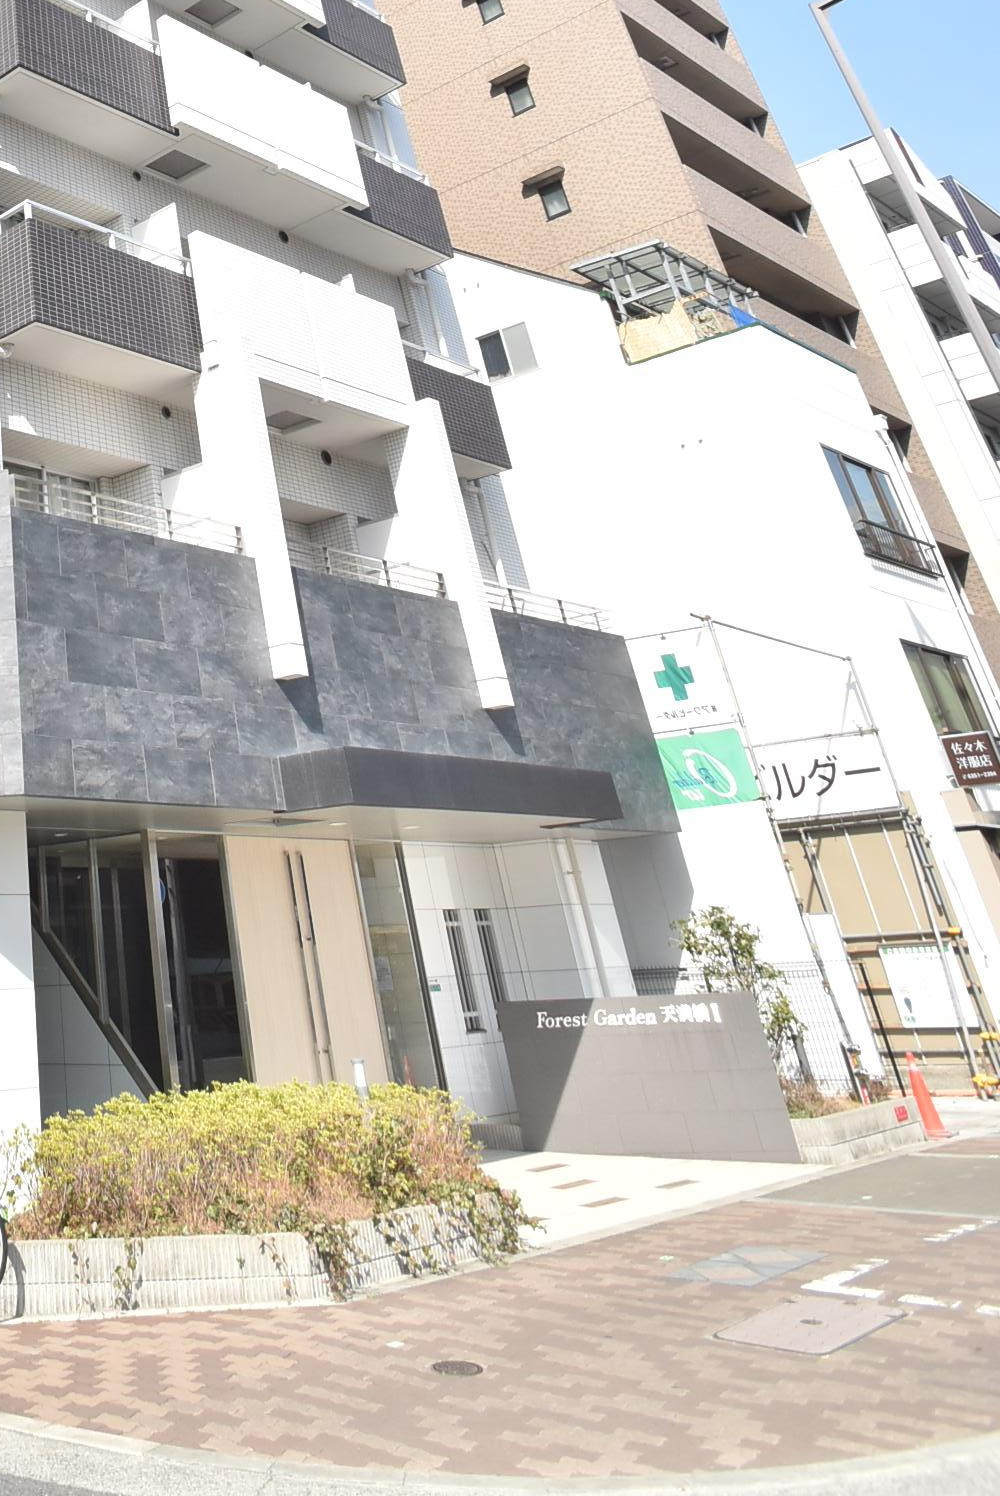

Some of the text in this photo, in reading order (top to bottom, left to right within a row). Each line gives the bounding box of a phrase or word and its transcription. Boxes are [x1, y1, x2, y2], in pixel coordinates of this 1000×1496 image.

[951, 739, 988, 755] 佐々木
[956, 754, 993, 770] 洋服店
[758, 754, 881, 801] ルダー
[536, 1011, 589, 1029] Forest
[593, 1008, 658, 1026] Garden
